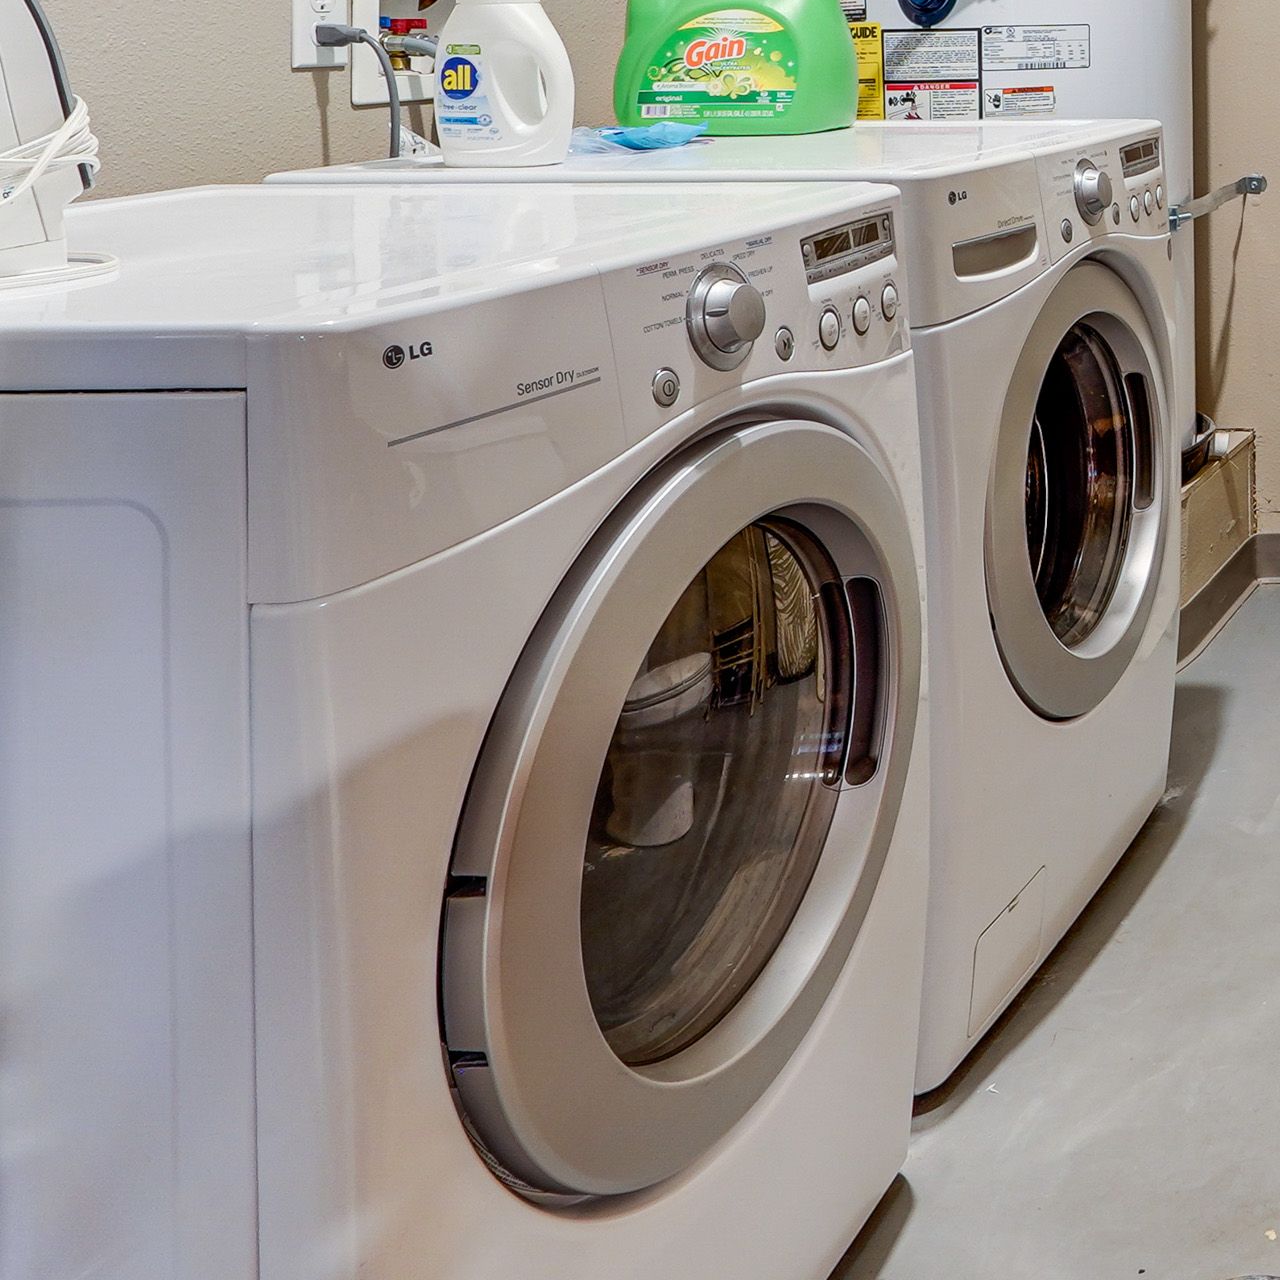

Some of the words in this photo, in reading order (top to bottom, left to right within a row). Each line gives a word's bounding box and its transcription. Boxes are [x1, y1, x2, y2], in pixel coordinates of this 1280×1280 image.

[686, 37, 745, 68] Gain
[443, 65, 471, 90] all
[958, 191, 968, 201] LG
[662, 292, 684, 301] NORMAL
[408, 341, 433, 360] LG
[516, 375, 554, 396] Sensor
[555, 369, 575, 386] Dry
